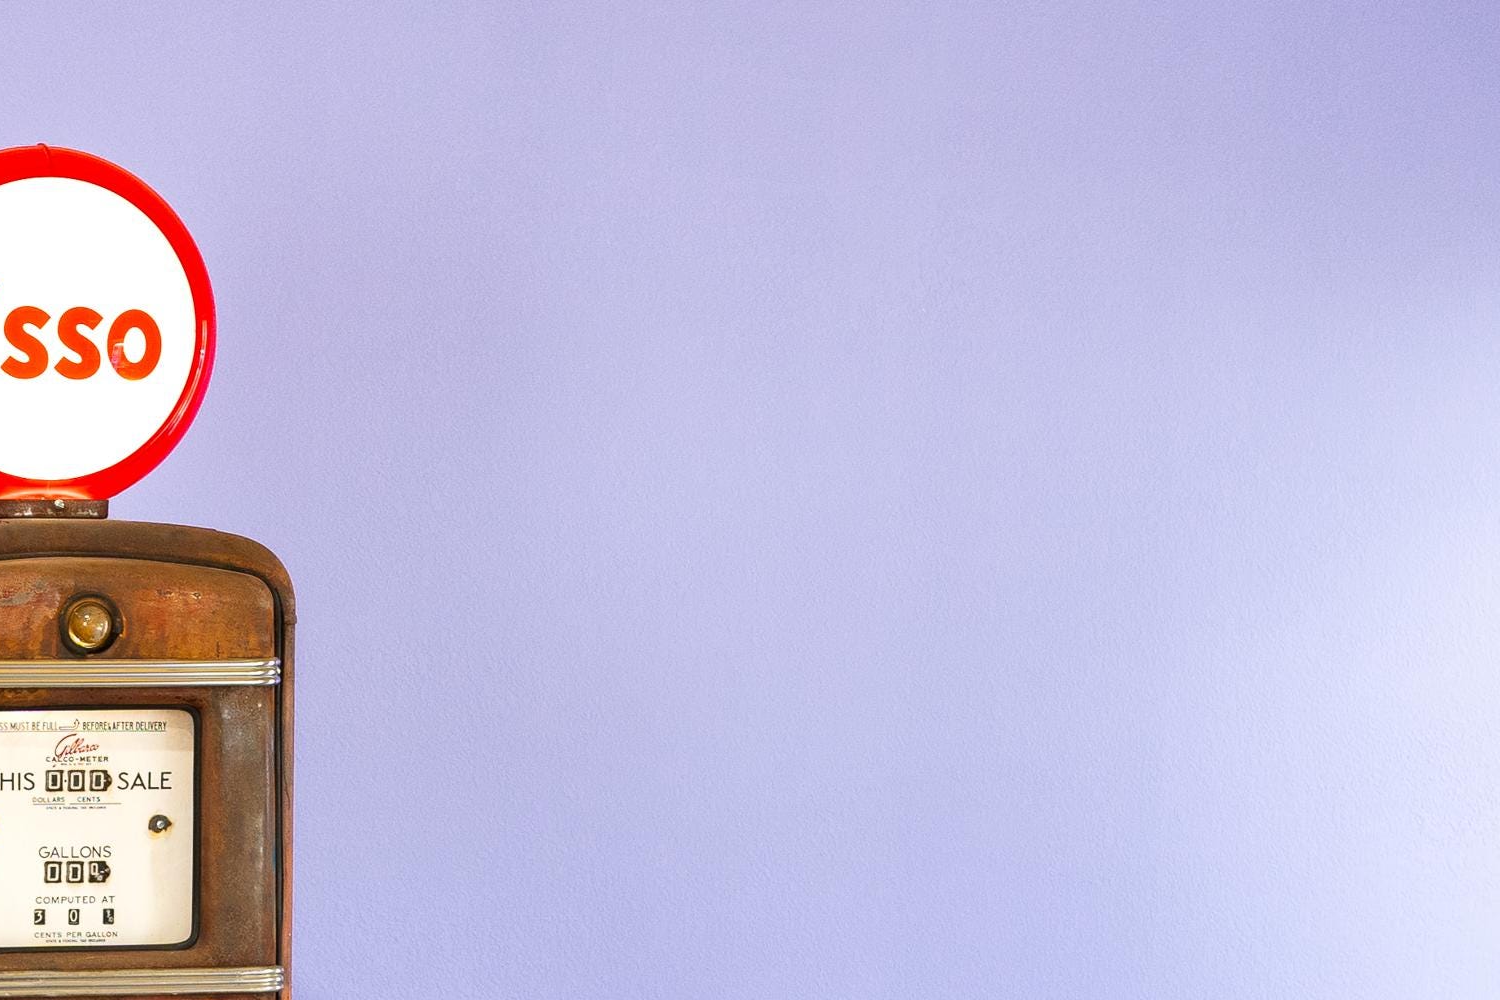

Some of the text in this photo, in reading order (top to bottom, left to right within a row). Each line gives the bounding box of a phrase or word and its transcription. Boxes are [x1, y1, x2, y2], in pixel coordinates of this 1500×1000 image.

[10, 721, 30, 731] MUST
[31, 721, 41, 731] BE
[42, 721, 58, 731] FULL
[135, 721, 167, 731] DELIVERY
[117, 771, 173, 791] SALE
[38, 845, 112, 859] GALLONS
[35, 895, 116, 905] COMPUTED AT
